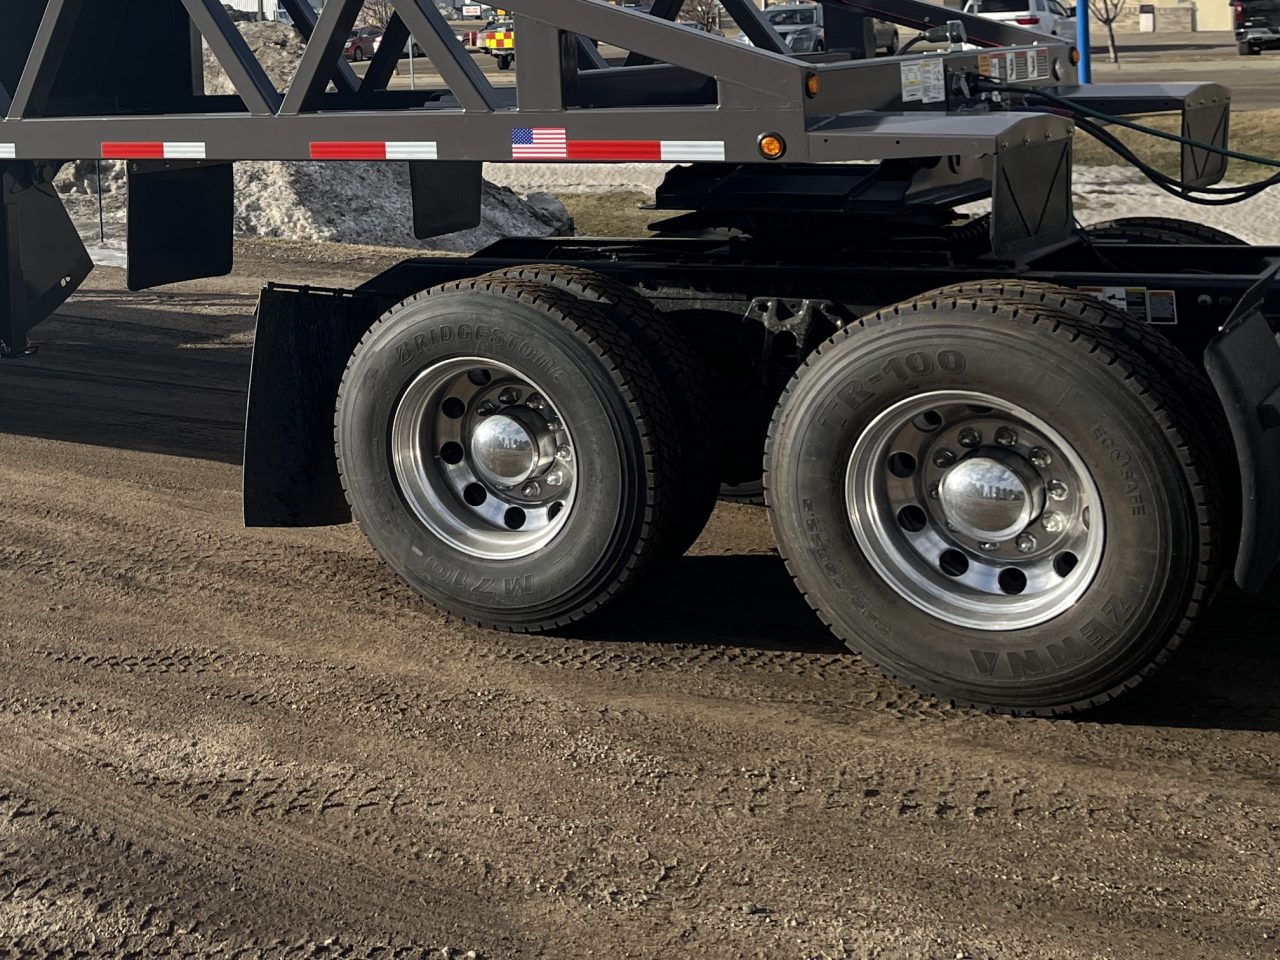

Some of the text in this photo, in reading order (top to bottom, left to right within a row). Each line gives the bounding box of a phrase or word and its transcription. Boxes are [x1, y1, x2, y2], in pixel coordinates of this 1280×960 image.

[394, 323, 568, 383] BRIDGESTONE
[819, 350, 967, 431] TR-100
[424, 555, 536, 599] M710
[971, 595, 1138, 678] ZENNA
